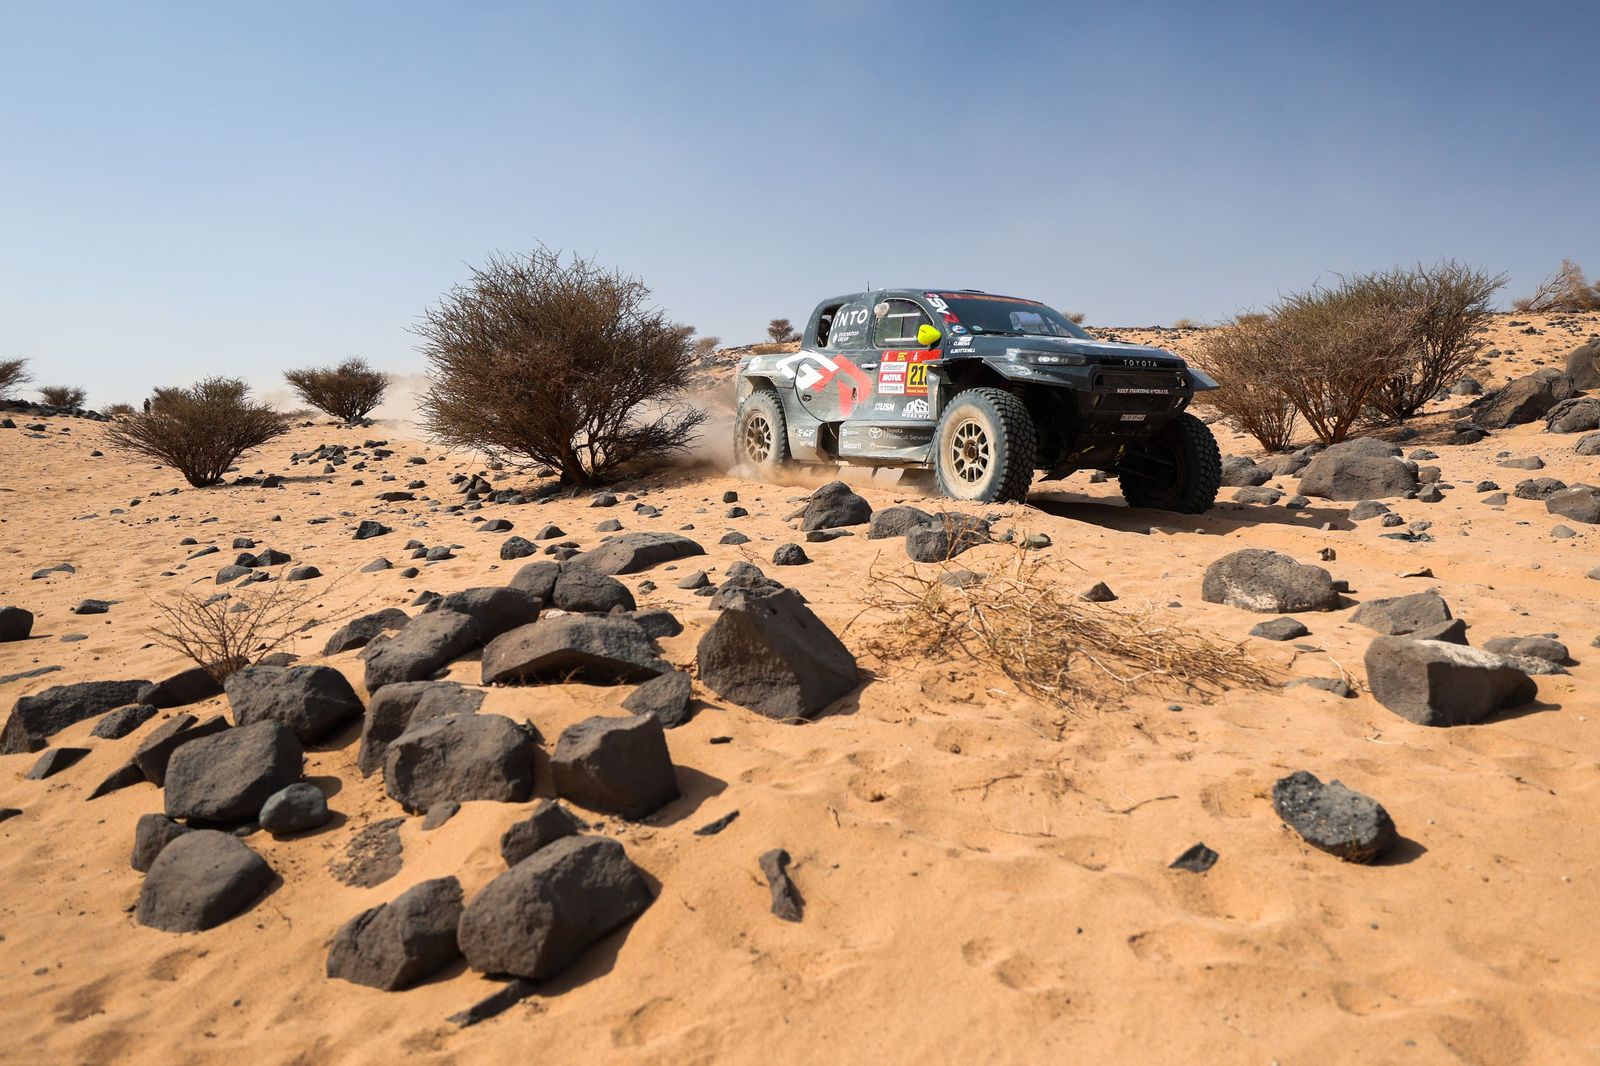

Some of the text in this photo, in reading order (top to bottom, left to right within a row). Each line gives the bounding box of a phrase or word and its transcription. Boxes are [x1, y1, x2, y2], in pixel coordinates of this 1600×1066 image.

[831, 309, 869, 330] INTO
[1123, 359, 1157, 367] TOYOTA
[881, 373, 902, 382] MOTUL
[903, 398, 930, 413] JONSSO
